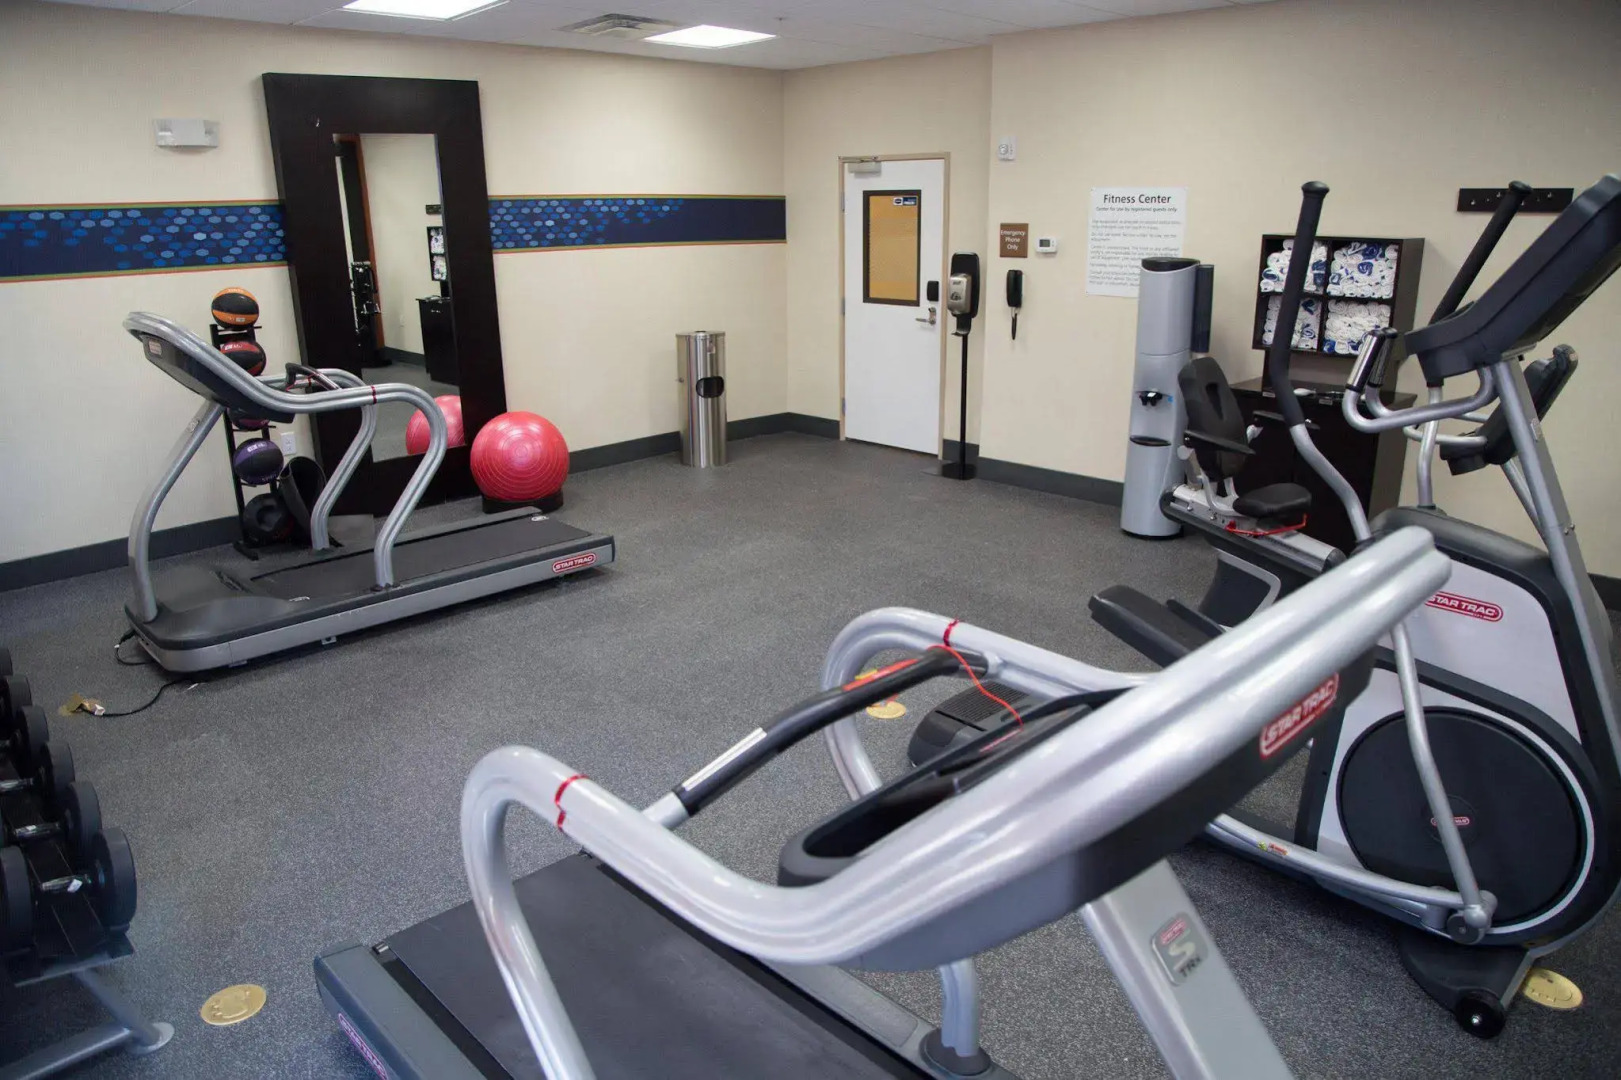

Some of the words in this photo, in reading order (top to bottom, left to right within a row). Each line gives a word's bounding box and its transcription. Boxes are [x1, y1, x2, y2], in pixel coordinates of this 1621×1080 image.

[1103, 194, 1136, 204] Fitness
[1138, 194, 1172, 204] Center
[555, 561, 574, 570] STAR
[574, 556, 593, 565] TRAC
[1460, 602, 1496, 616] TRAC
